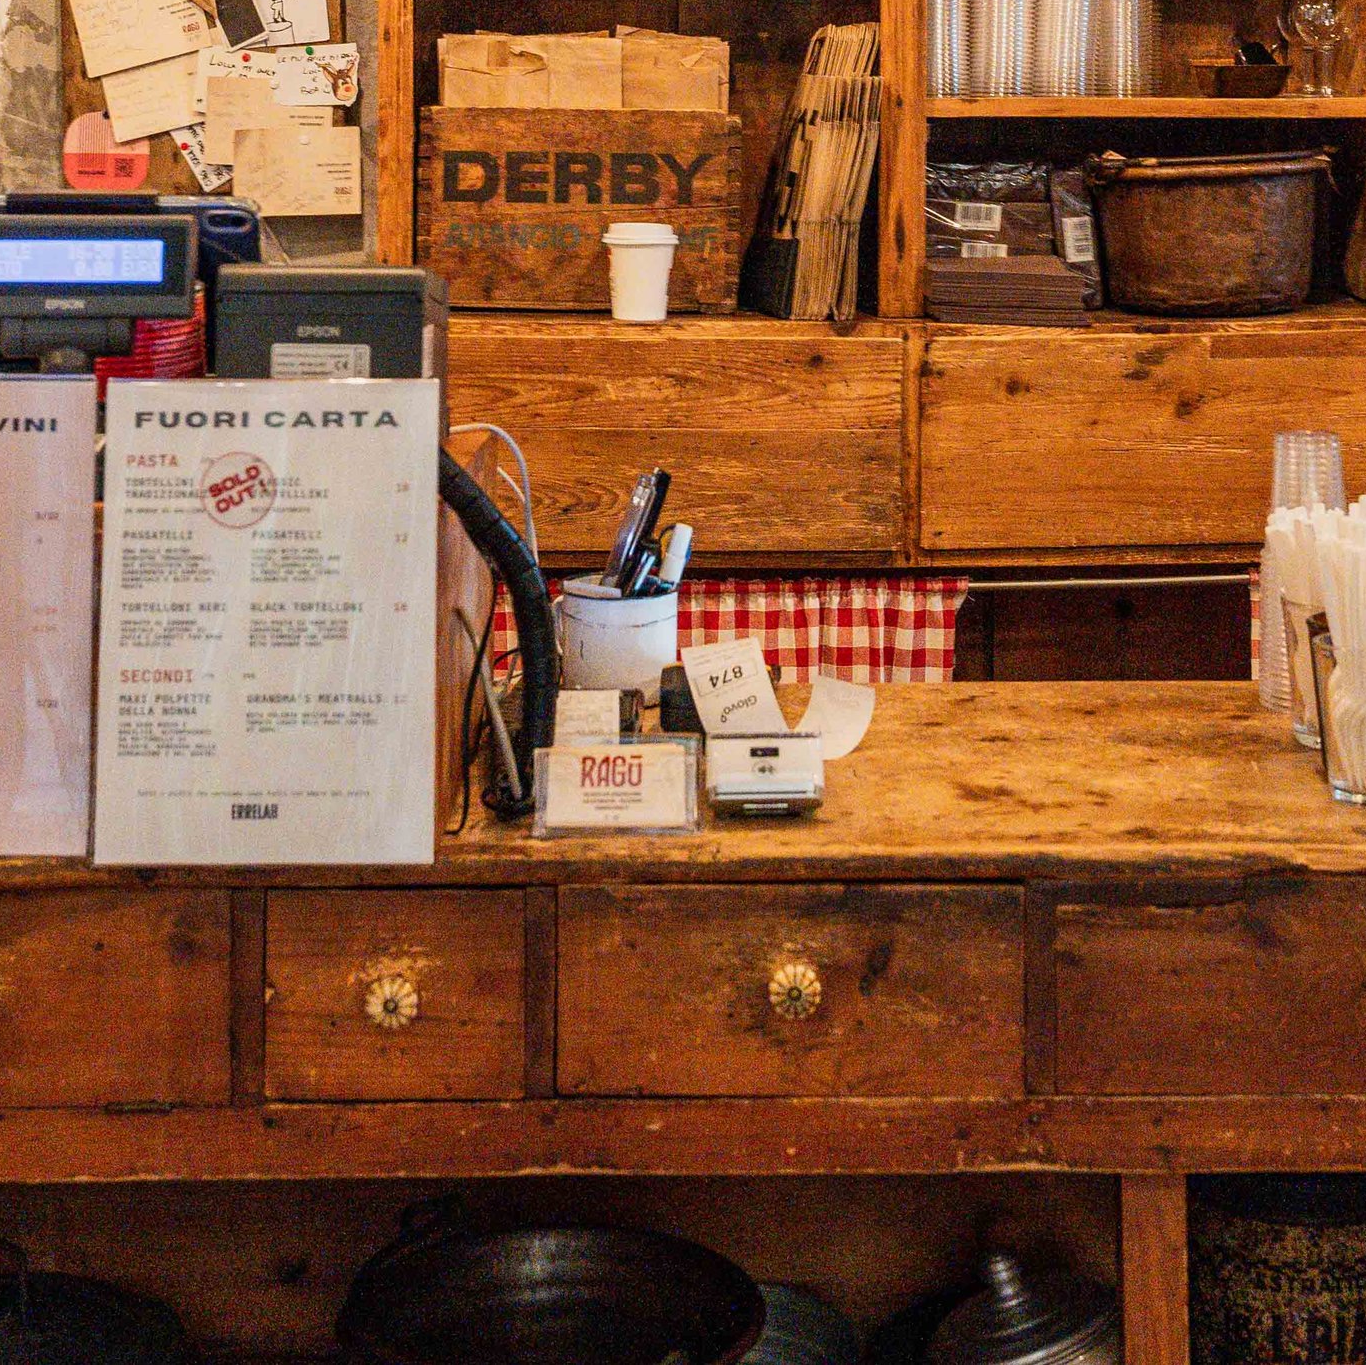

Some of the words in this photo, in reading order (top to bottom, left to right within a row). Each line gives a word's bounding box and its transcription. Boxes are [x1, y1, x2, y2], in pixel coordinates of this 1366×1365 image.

[442, 150, 716, 205] DERBY
[135, 411, 249, 428] FUORI
[264, 411, 399, 428] CARTA
[126, 454, 178, 468] PASTA
[208, 464, 261, 499] SOLD
[120, 670, 194, 683] SECONDI
[709, 665, 743, 688] 874
